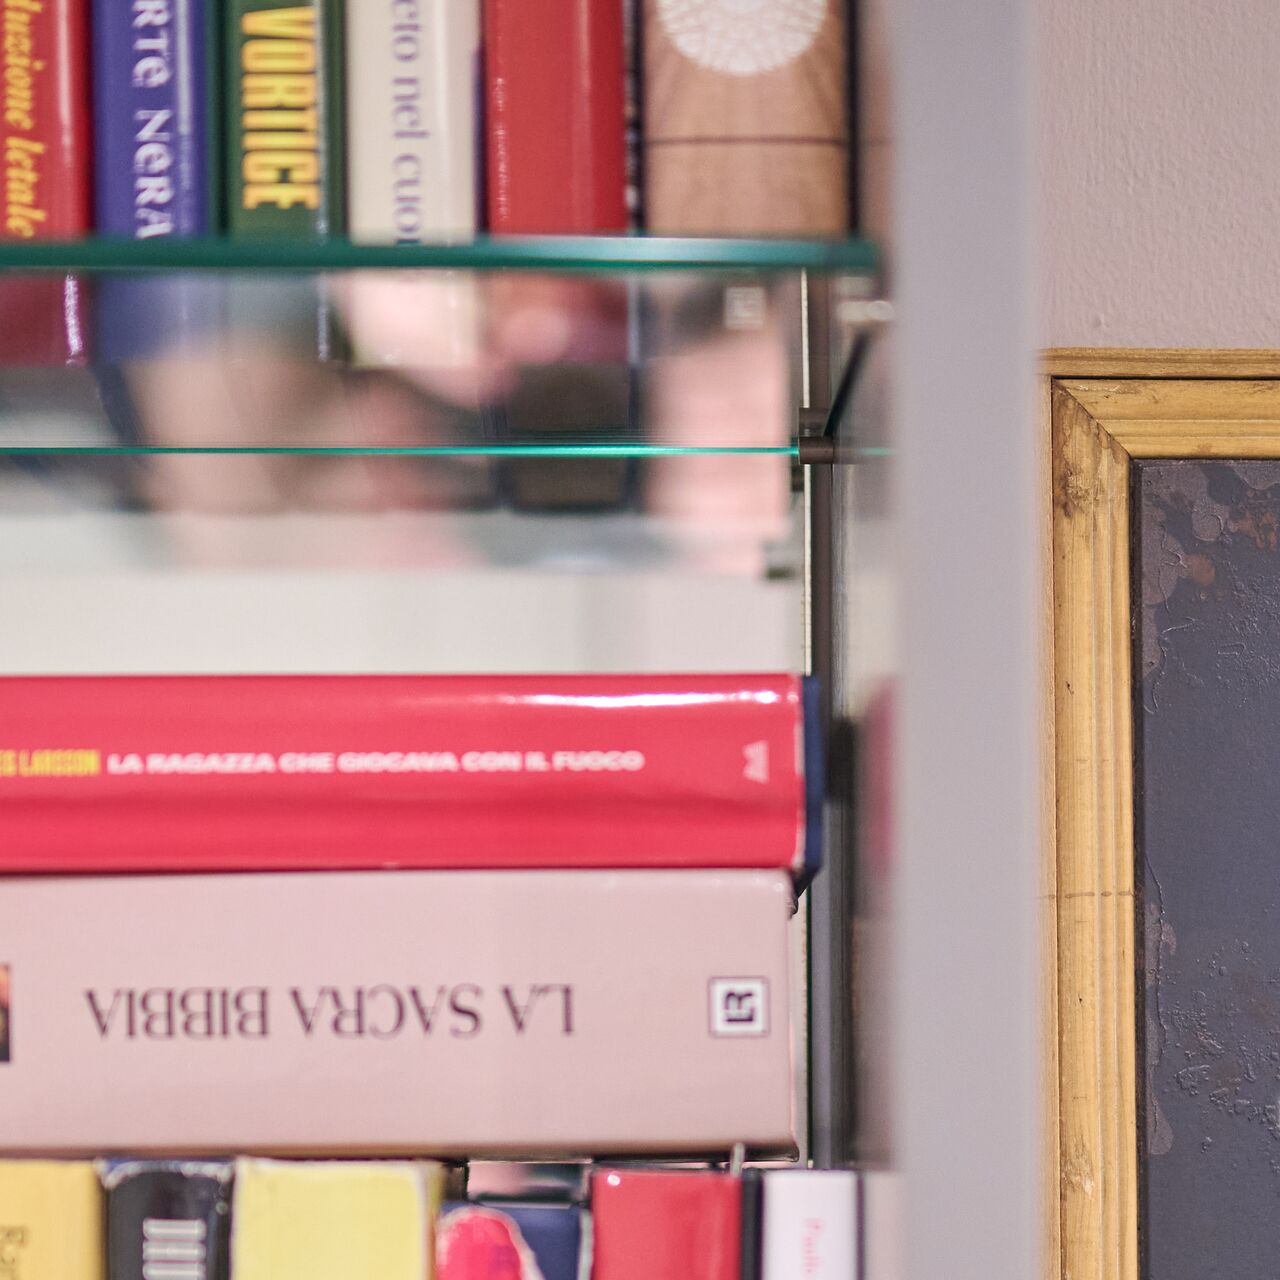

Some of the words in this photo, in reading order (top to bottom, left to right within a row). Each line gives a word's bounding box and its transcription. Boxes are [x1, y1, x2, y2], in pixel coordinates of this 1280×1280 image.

[241, 5, 318, 210] VORTICE
[392, 77, 431, 139] nel
[5, 136, 47, 238] letale
[107, 752, 144, 774] LA
[146, 751, 275, 774] RAGAZZA
[279, 751, 334, 773] CHE
[337, 750, 459, 773] GIOCAVA
[461, 750, 522, 773] CON
[524, 750, 551, 772] IL
[552, 749, 644, 772] FUOCO
[87, 985, 270, 1041] BIBBIA
[290, 982, 482, 1039] SACRA
[500, 981, 576, 1035] LA
